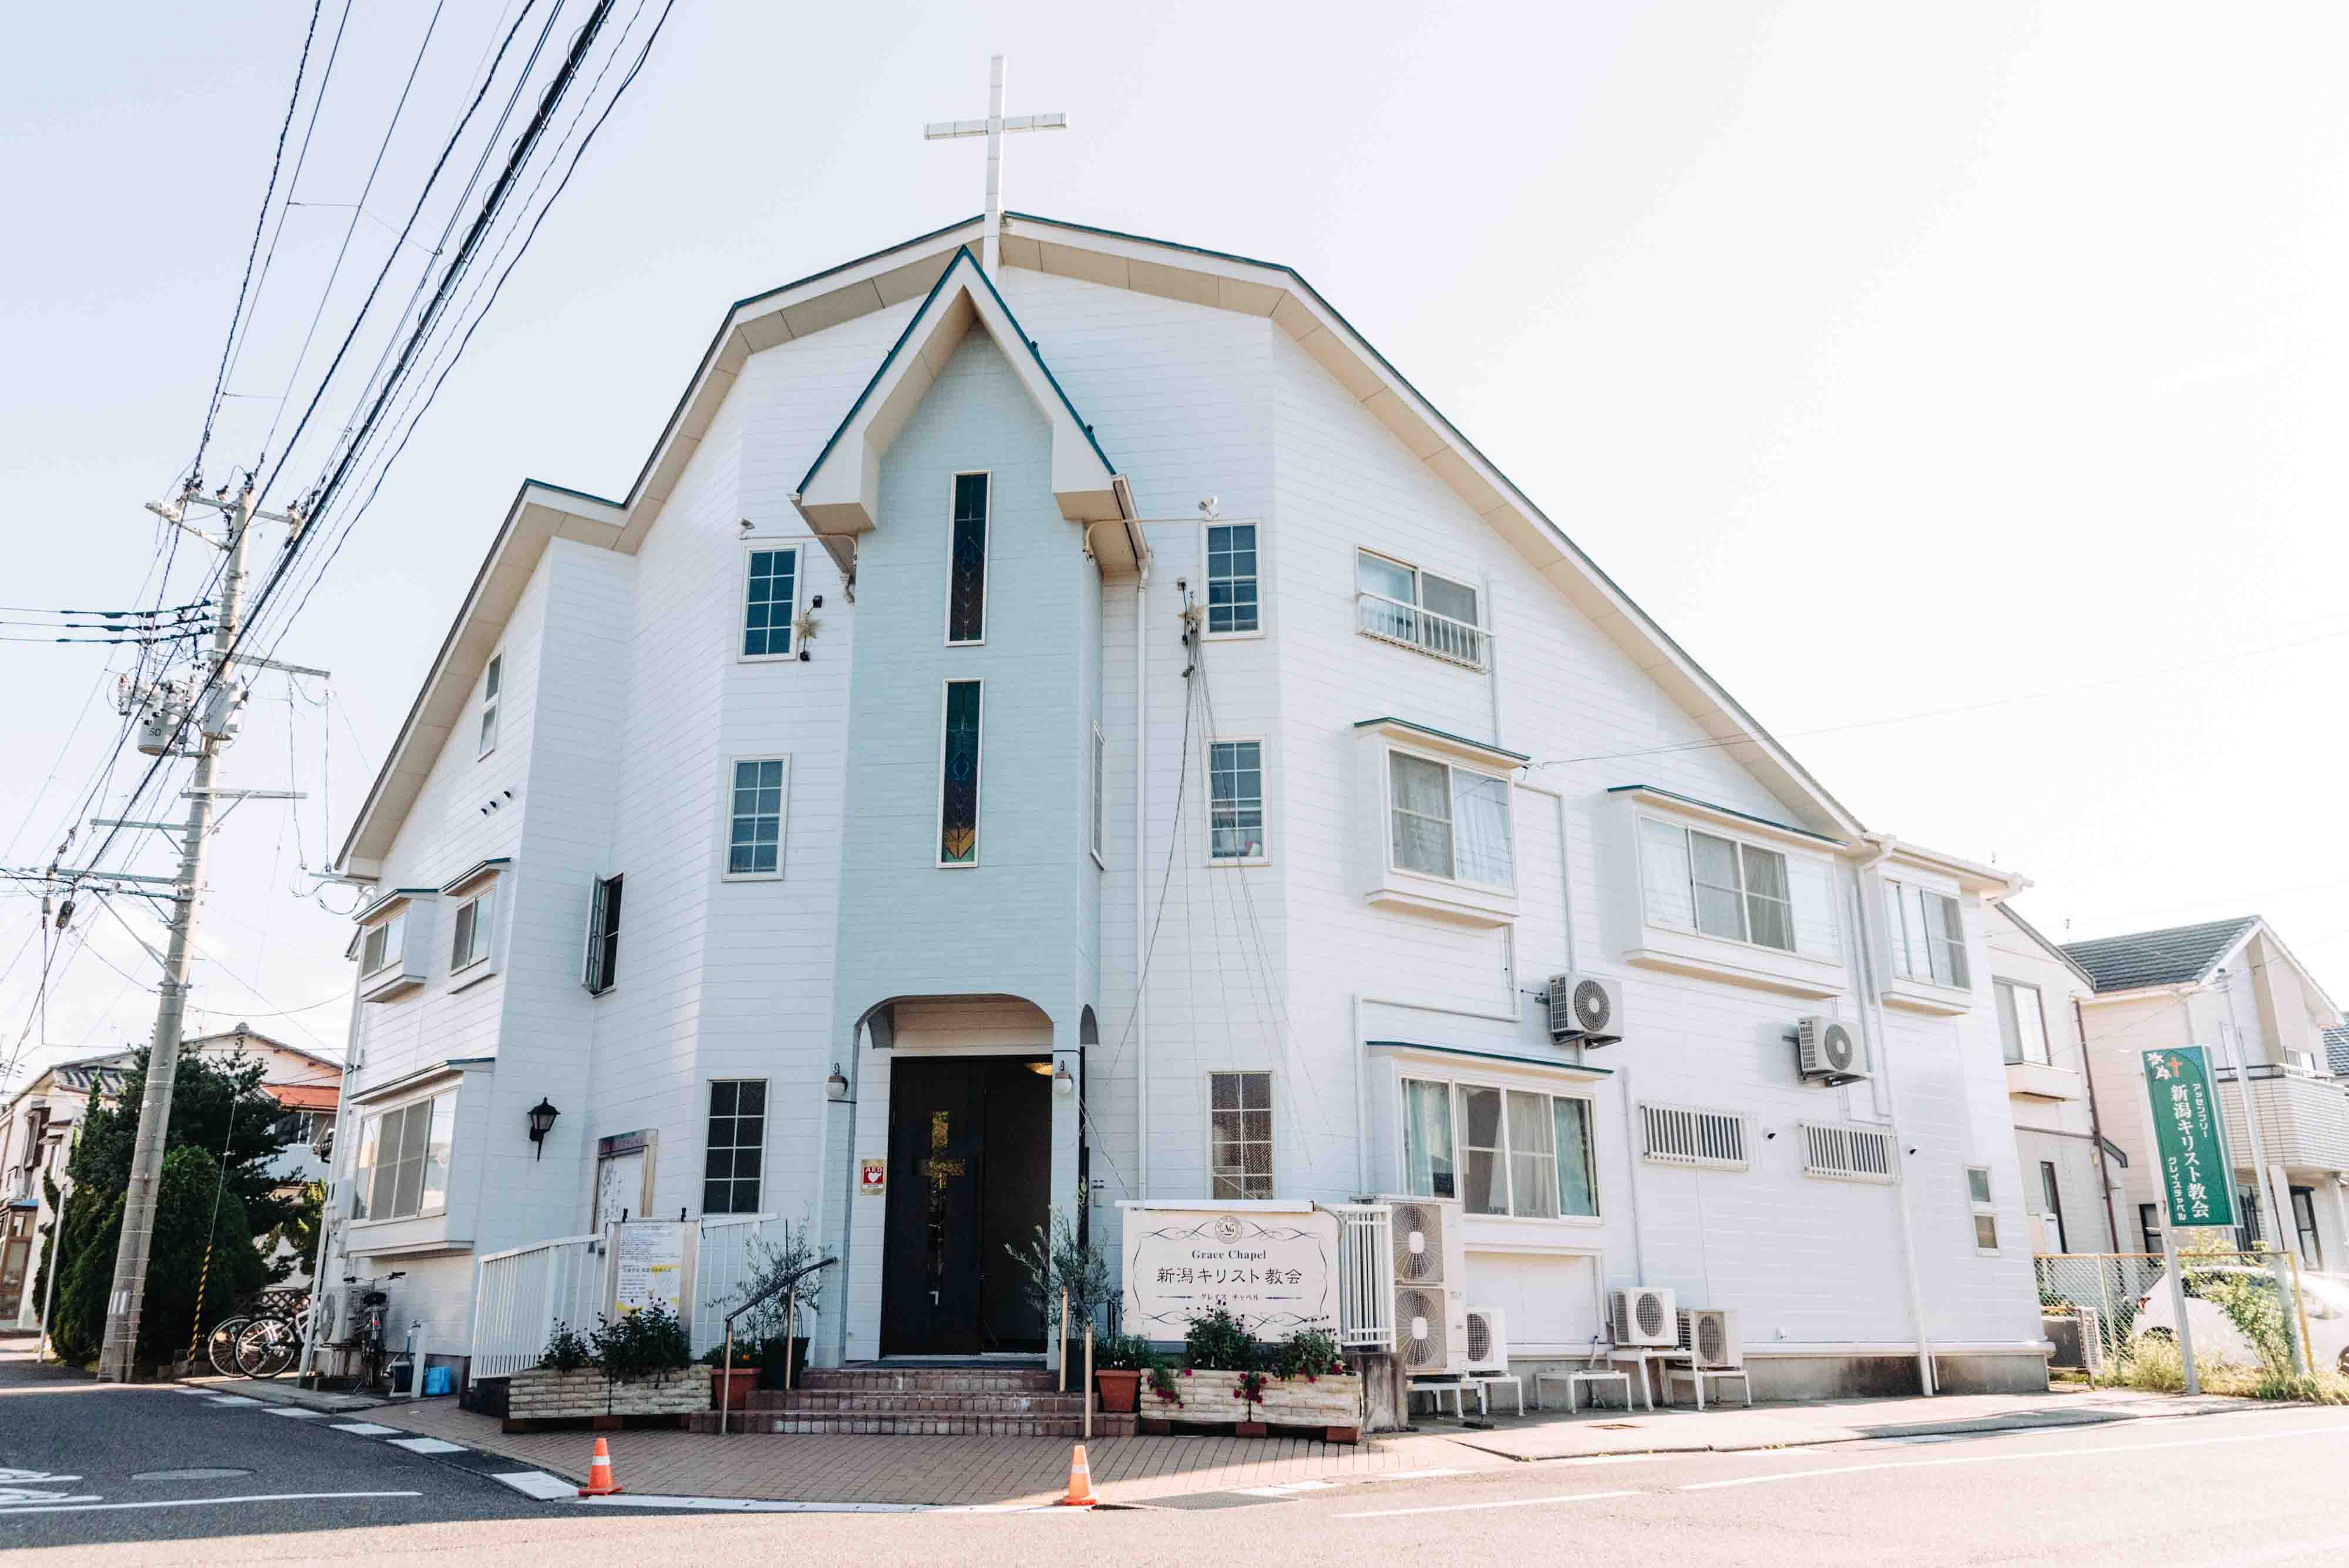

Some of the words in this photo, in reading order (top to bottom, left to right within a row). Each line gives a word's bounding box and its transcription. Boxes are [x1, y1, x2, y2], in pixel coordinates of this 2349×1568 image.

[2170, 1084, 2209, 1218] 新潟キリスト教会
[1192, 1250, 1225, 1259] Grace
[1228, 1249, 1266, 1261] Chapel
[1156, 1267, 1303, 1285] 新潟キリスト教会
[1201, 1293, 1227, 1301] グレイス
[1231, 1293, 1258, 1301] チャペル
